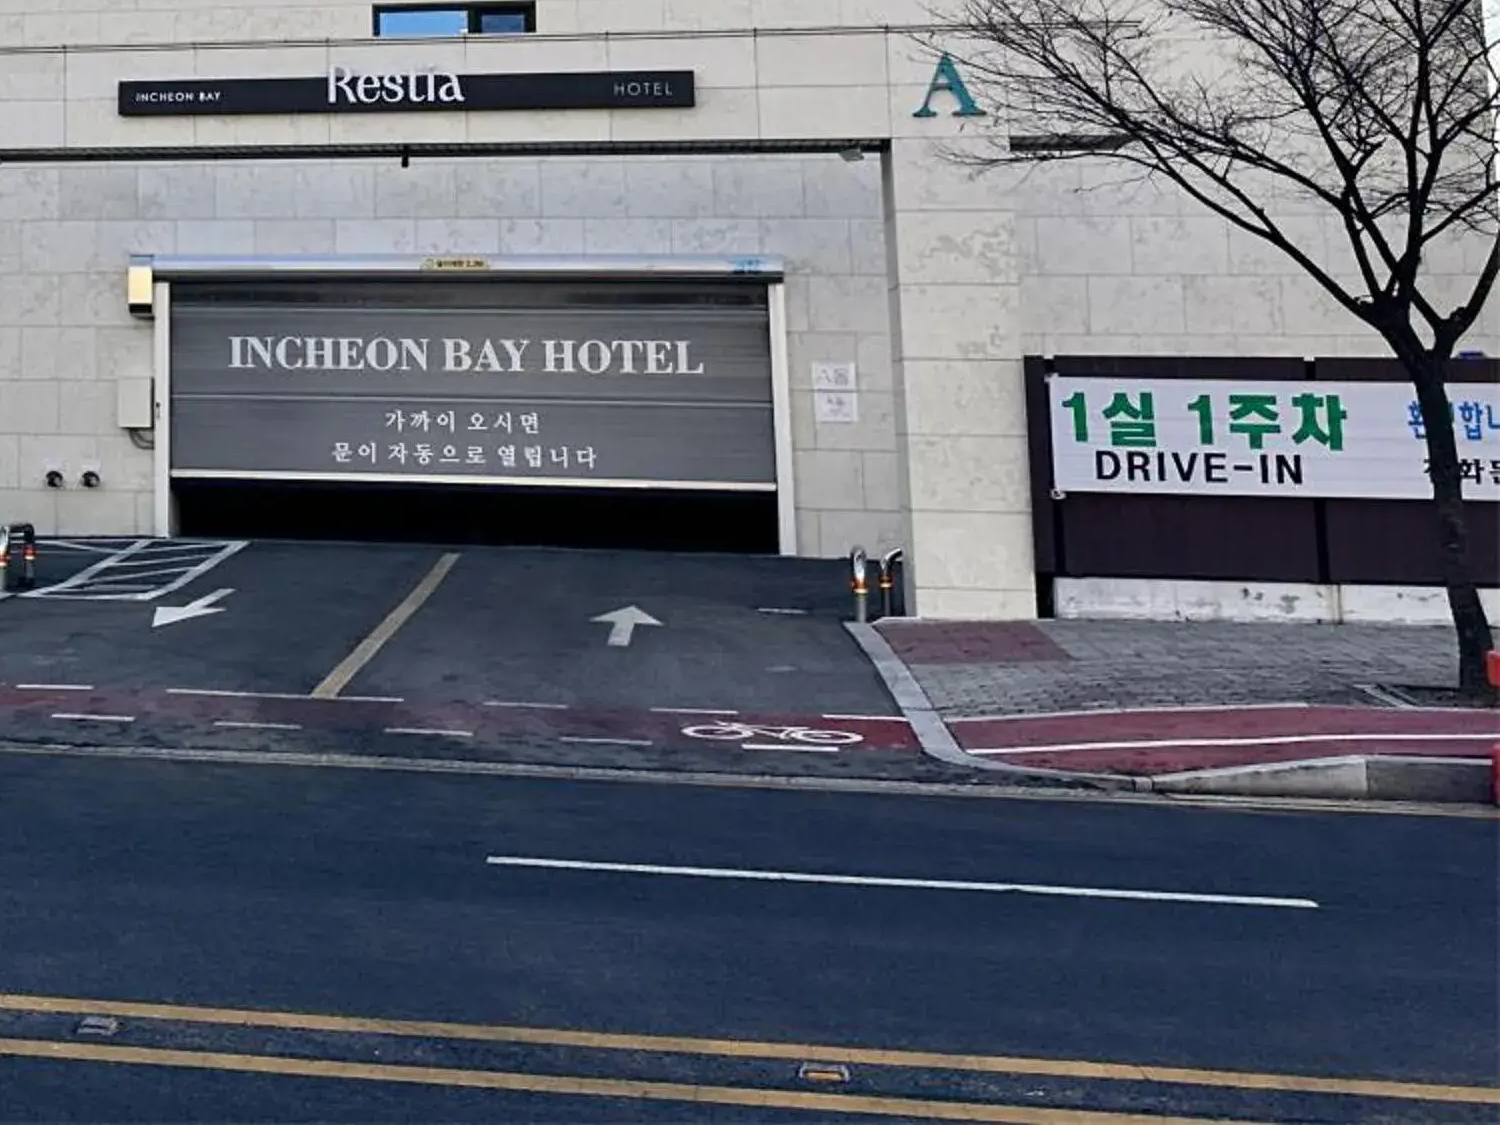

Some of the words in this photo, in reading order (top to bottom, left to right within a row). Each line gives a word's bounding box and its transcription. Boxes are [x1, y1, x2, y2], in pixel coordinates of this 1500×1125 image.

[135, 91, 194, 103] INCHEON
[199, 91, 221, 102] BAY
[326, 65, 466, 104] Restia
[613, 81, 674, 97] HOTEL
[912, 51, 987, 117] A
[228, 336, 429, 372] INCHEON
[443, 338, 530, 373] BAY
[541, 339, 705, 375] HOTEL
[385, 409, 456, 434] 가까이
[466, 411, 541, 435] 오시면
[1062, 391, 1158, 447] 1실
[1187, 393, 1348, 452] 1주차
[1407, 400, 1500, 441] 환합
[332, 442, 377, 464] 문이
[387, 442, 488, 466] 자동으로
[497, 443, 598, 469] 열립니다
[1094, 450, 1304, 485] DRIVE-IN
